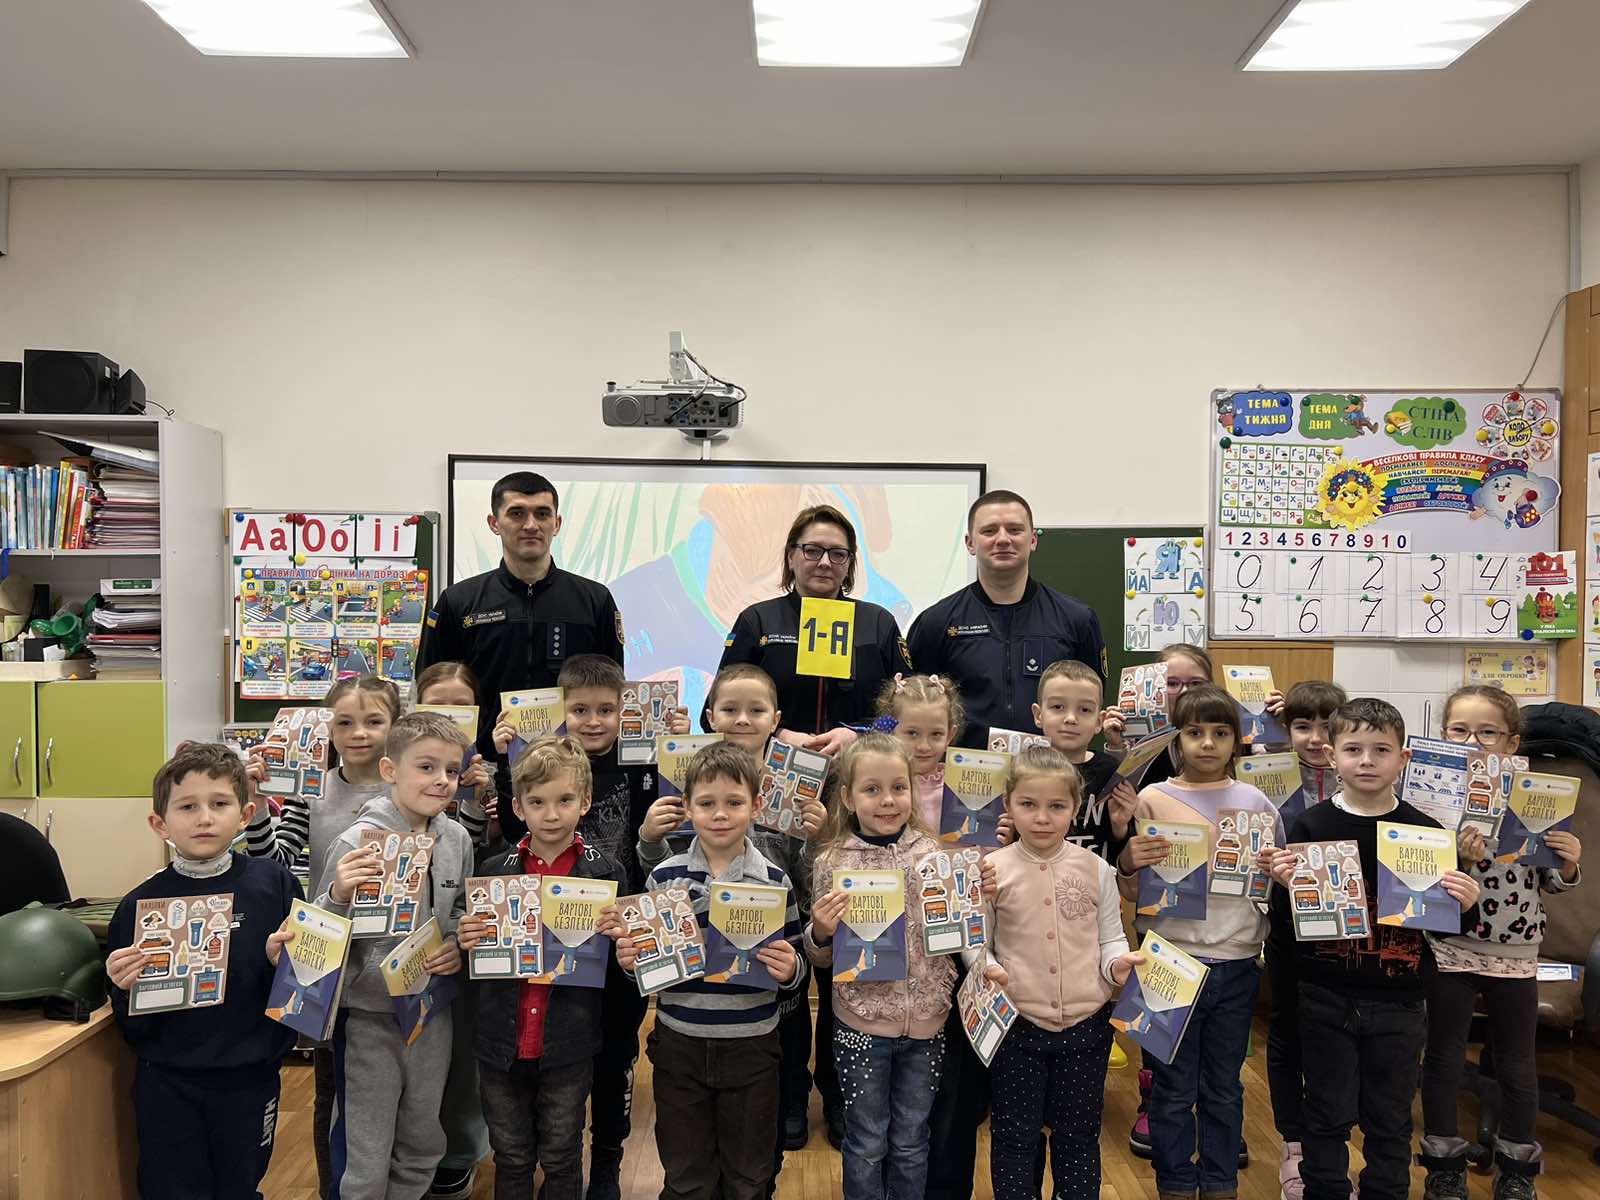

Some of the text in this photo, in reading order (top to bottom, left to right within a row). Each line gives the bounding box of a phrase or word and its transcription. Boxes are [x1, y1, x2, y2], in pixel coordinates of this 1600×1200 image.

[1248, 399, 1278, 408] ТЕМА
[1310, 405, 1338, 414] ТЕМА
[1245, 415, 1287, 424] ТИЖНЯ
[1309, 420, 1331, 430] ДНЯ
[1374, 452, 1417, 466] ВЕСЕЛКОВІ
[1460, 453, 1486, 463] КЛАСУ
[1226, 532, 1232, 544] 1
[1242, 532, 1251, 545] 2
[1260, 532, 1269, 545] 3
[1277, 533, 1287, 545] 4
[1294, 533, 1304, 546] 5
[1312, 533, 1321, 546] 6
[1330, 534, 1339, 546] 7
[1347, 534, 1356, 547] 8
[1364, 535, 1373, 547] 9
[261, 570, 300, 578] ПРАВИЛА
[306, 570, 356, 579] ПОВДІНКИ
[359, 570, 370, 578] НА
[1188, 571, 1204, 590] А
[1237, 555, 1508, 591] 0 1 2 3 4
[1129, 571, 1148, 591] ЙА
[1154, 601, 1179, 626] Ю
[1235, 598, 1510, 633] 5 6 7 8 9
[803, 618, 849, 656] 1-А
[520, 707, 549, 720] ВАРТОВІ
[518, 719, 552, 733] БЕЗПЕКИ
[961, 768, 991, 785] ВАРТОВІ
[1254, 775, 1282, 786] ВАРТОВІ
[958, 782, 993, 797] БЕЗПЕКИ
[1527, 794, 1557, 807] ВАРТОВІ
[1521, 805, 1557, 820] БЕЗПЕКИ
[1399, 846, 1434, 863] ВАРТОВІ
[1396, 861, 1438, 877] БЕЗПЕКИ
[559, 902, 593, 917] ВАРТОВІ
[852, 895, 884, 909] ВАРТОВІ
[729, 908, 763, 923] ВАРТОВІ
[850, 909, 887, 924] БЕЗПЕКИ
[554, 916, 594, 931] БЕЗПЕКИ
[725, 921, 765, 935] БЕЗПЕКИ
[300, 931, 328, 954] ВАРТОВІ
[293, 945, 326, 972] БЕЗПЕКИ
[1150, 961, 1180, 988] ВАРТОВІ
[1143, 973, 1177, 1004] БЕЗПЕКИ
